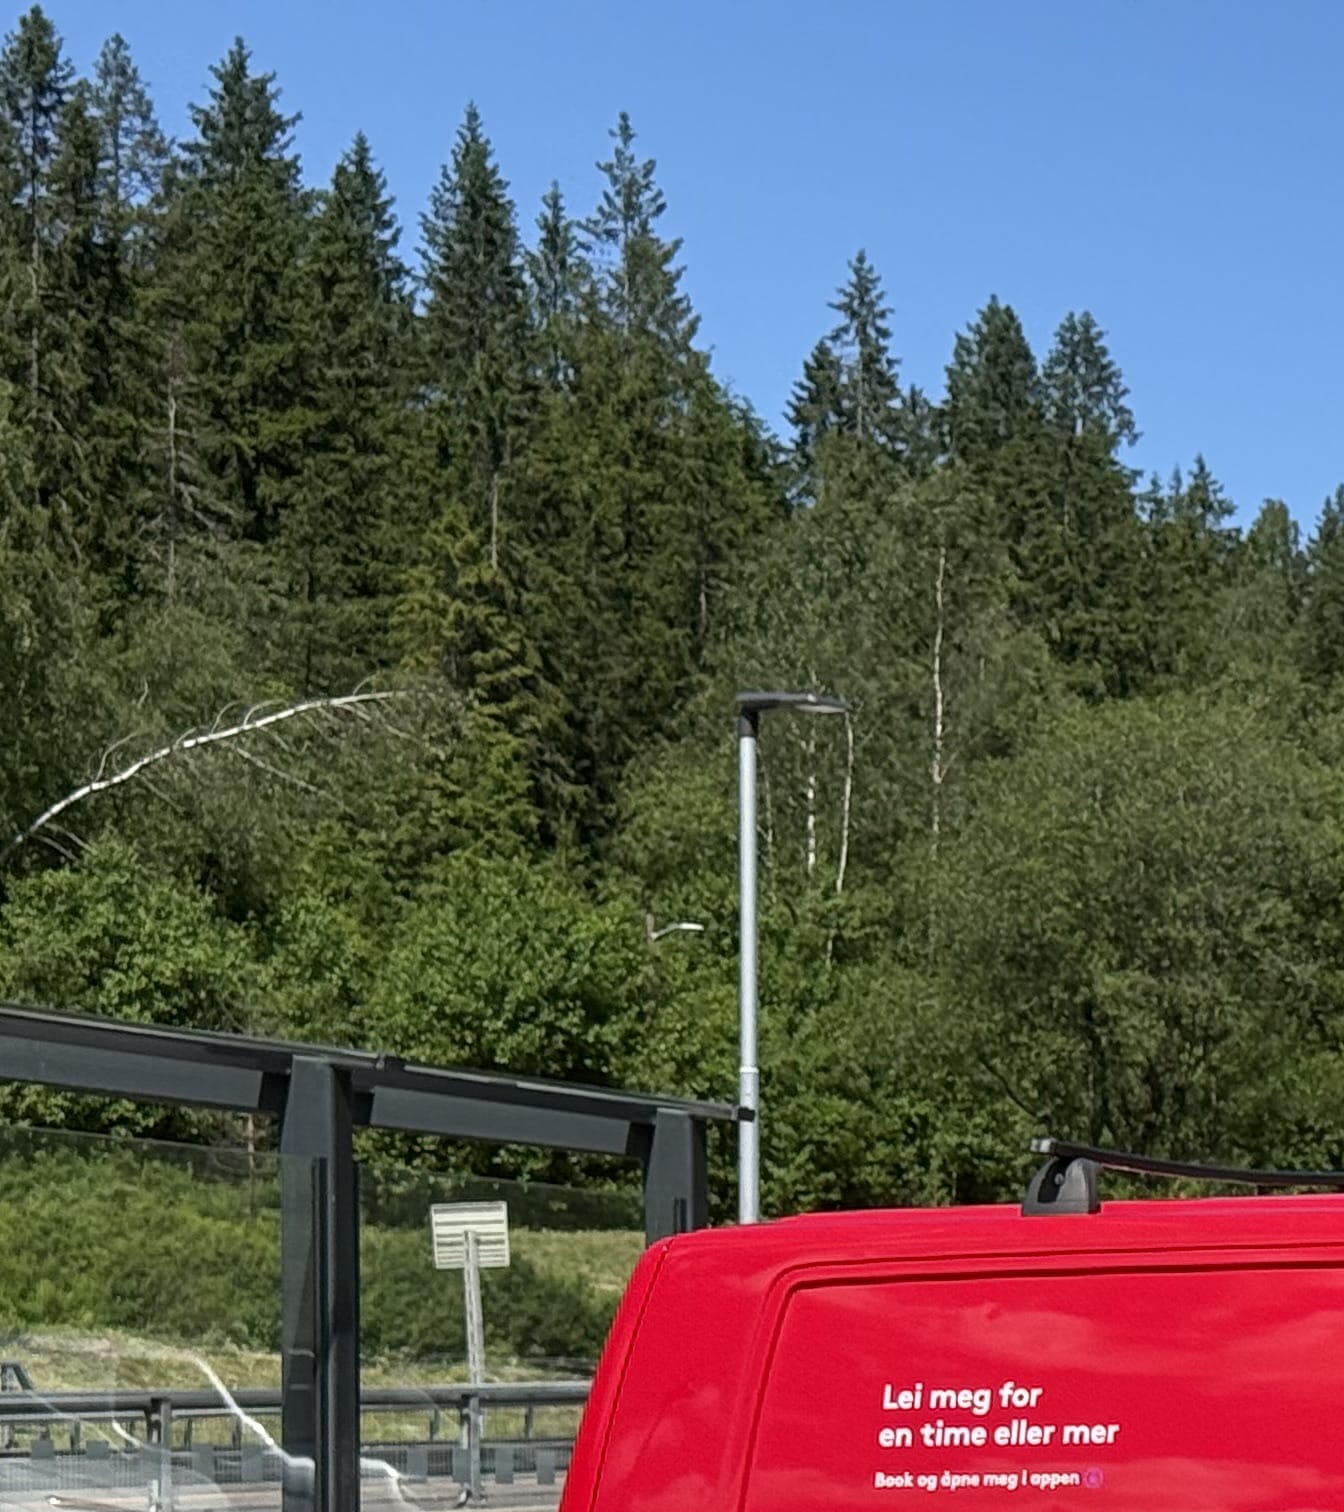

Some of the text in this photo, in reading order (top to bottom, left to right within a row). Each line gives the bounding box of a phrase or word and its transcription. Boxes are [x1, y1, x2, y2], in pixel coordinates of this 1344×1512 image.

[882, 1381, 1043, 1415] Lei meg for
[878, 1419, 1120, 1447] en time eller mer
[874, 1471, 914, 1488] Book
[917, 1474, 938, 1491] og
[941, 1469, 980, 1492] åpne
[983, 1473, 1018, 1490] meg
[1030, 1472, 1080, 1490] appen
